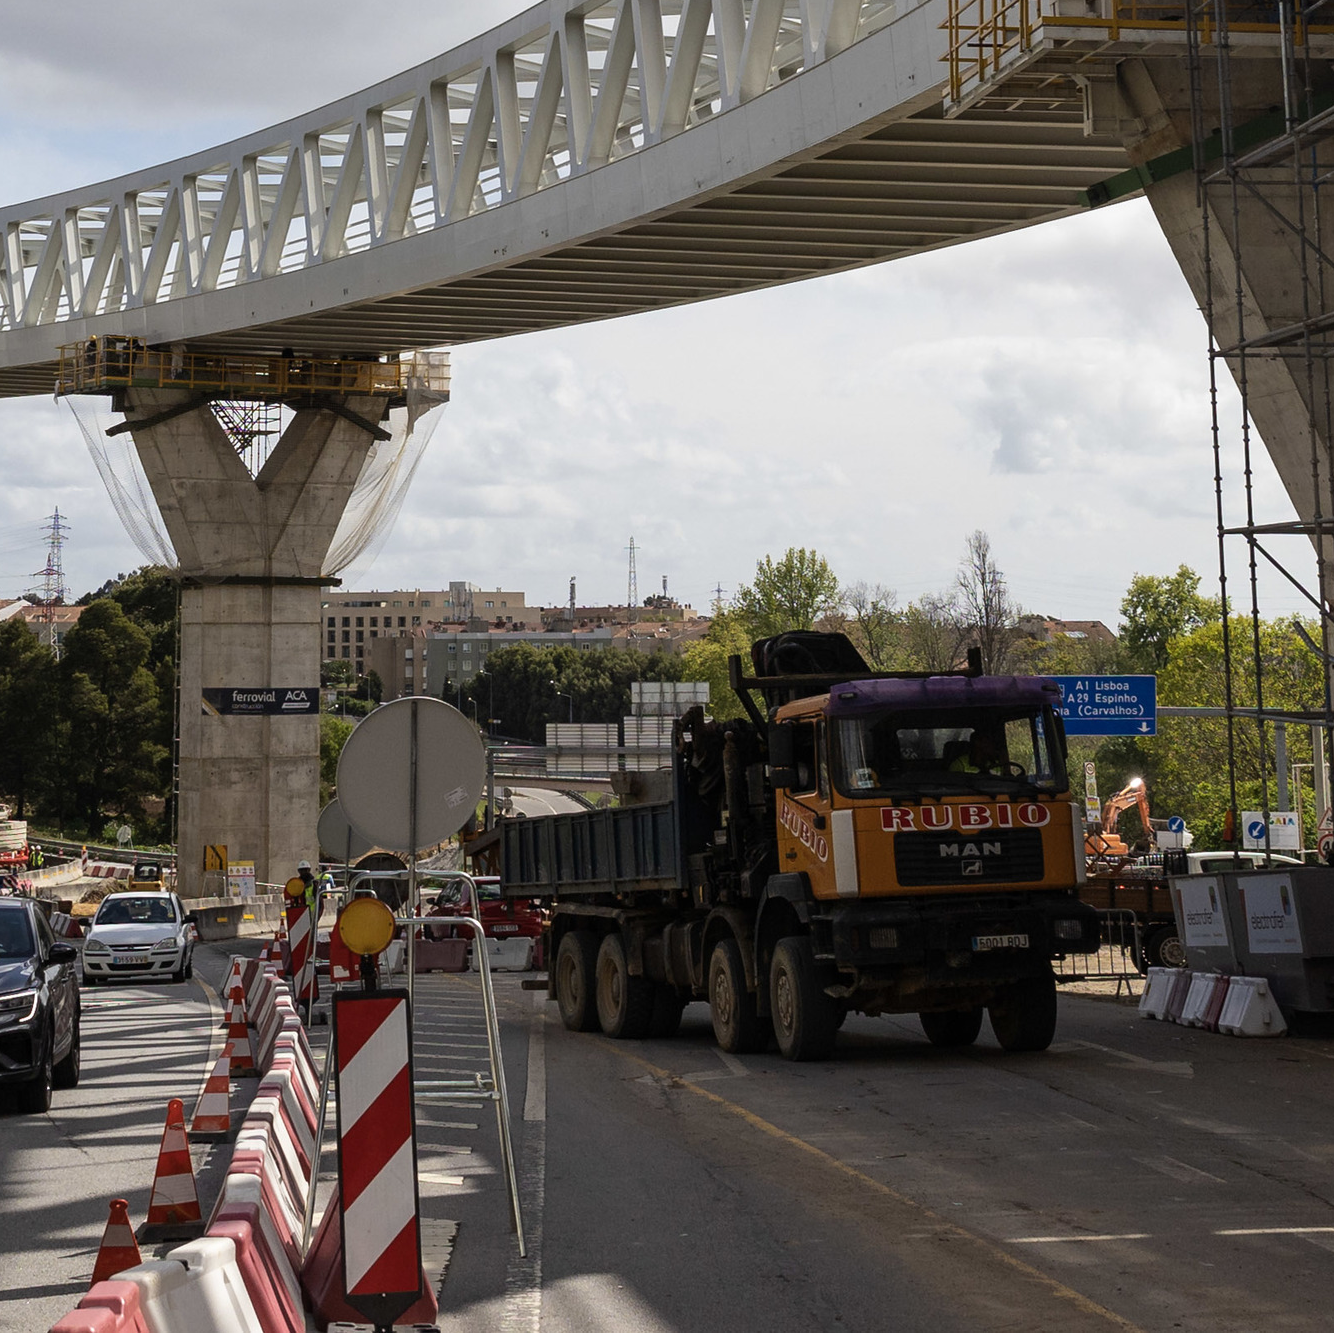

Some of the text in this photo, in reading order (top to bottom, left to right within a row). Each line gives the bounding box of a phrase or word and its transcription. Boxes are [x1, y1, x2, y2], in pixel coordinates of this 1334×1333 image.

[1076, 681, 1129, 690] A1 Lisboa
[232, 690, 307, 702] ferrovial ACA
[1095, 693, 1138, 704] Espinho
[1078, 704, 1144, 716] (Carvalhos)
[880, 803, 1050, 831] RUBIO
[780, 800, 828, 862] RUBIO
[939, 842, 1002, 857] MAN
